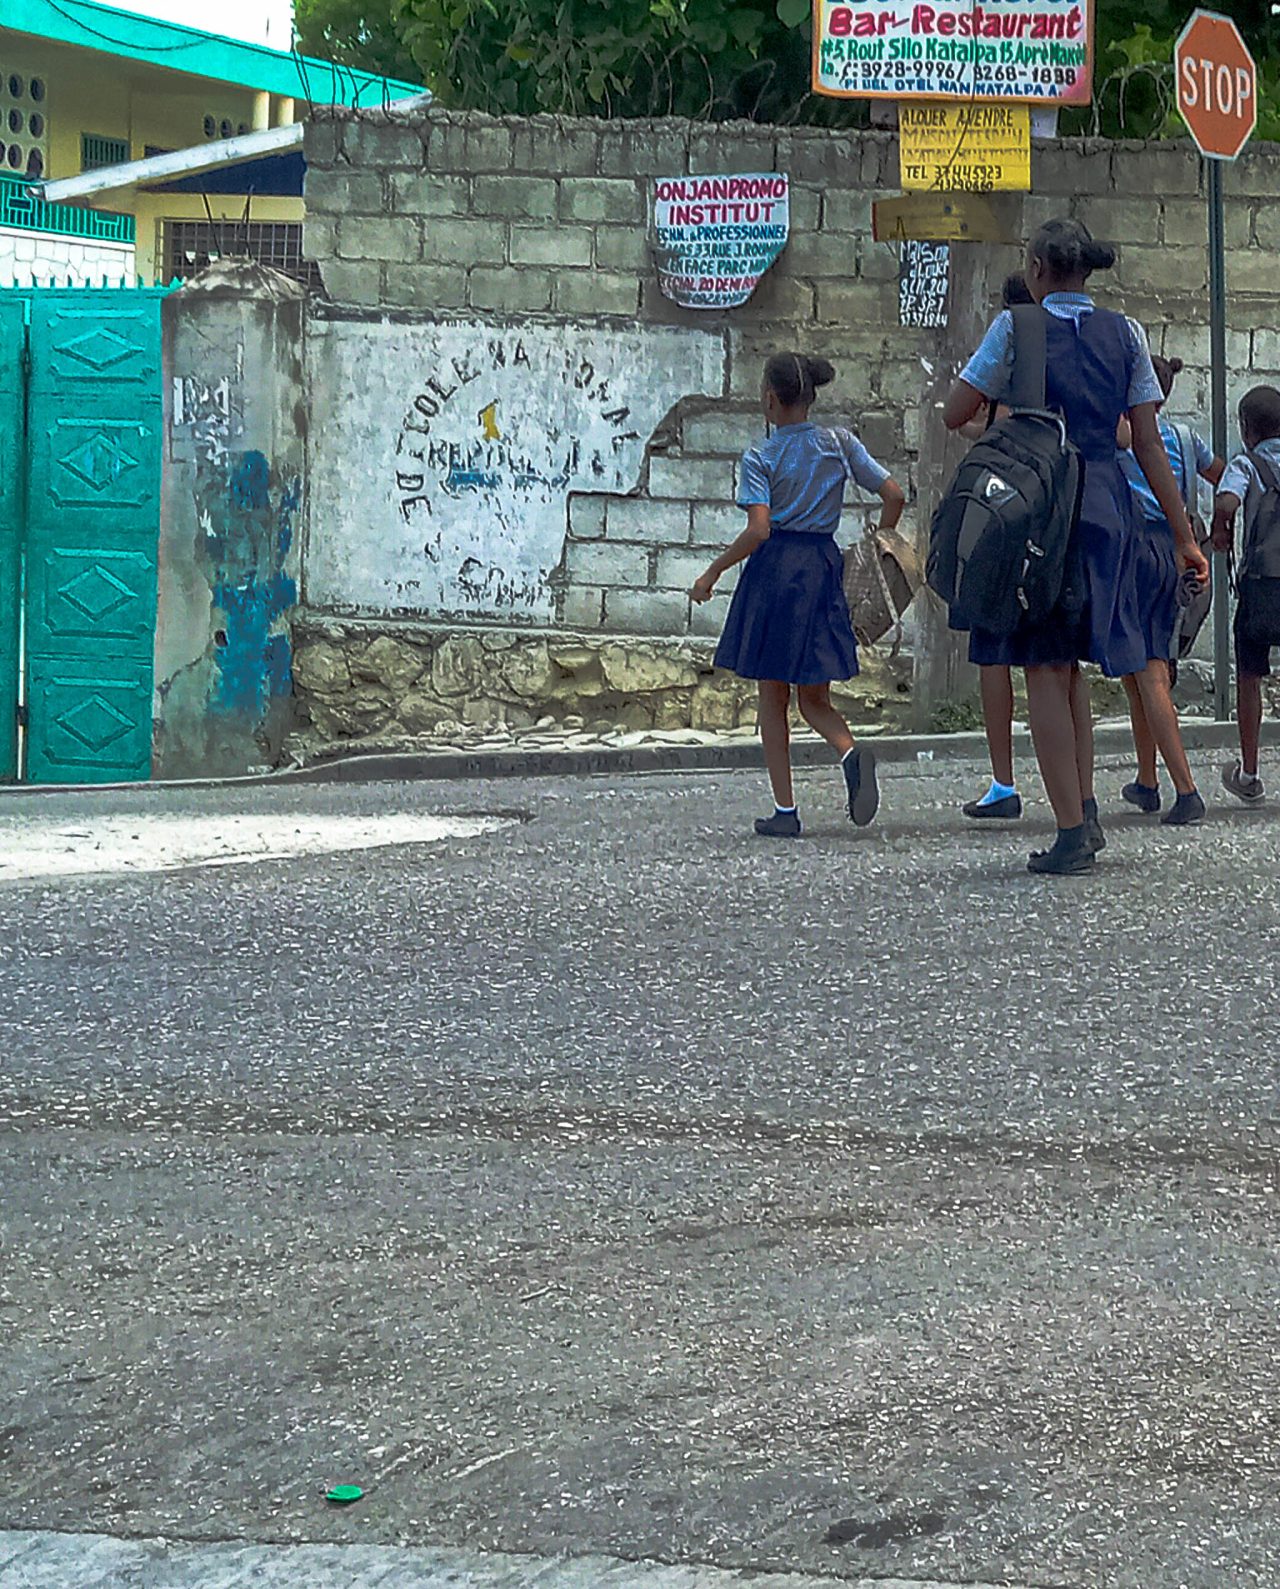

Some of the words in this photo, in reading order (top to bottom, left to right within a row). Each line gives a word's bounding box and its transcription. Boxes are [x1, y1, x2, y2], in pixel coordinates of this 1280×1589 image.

[888, 36, 923, 60] Silo
[1182, 56, 1250, 118] STOP
[905, 165, 928, 179] TEL
[654, 178, 786, 201] ONJANPROMO
[669, 203, 775, 226] INSTITUT
[717, 260, 748, 276] PARC
